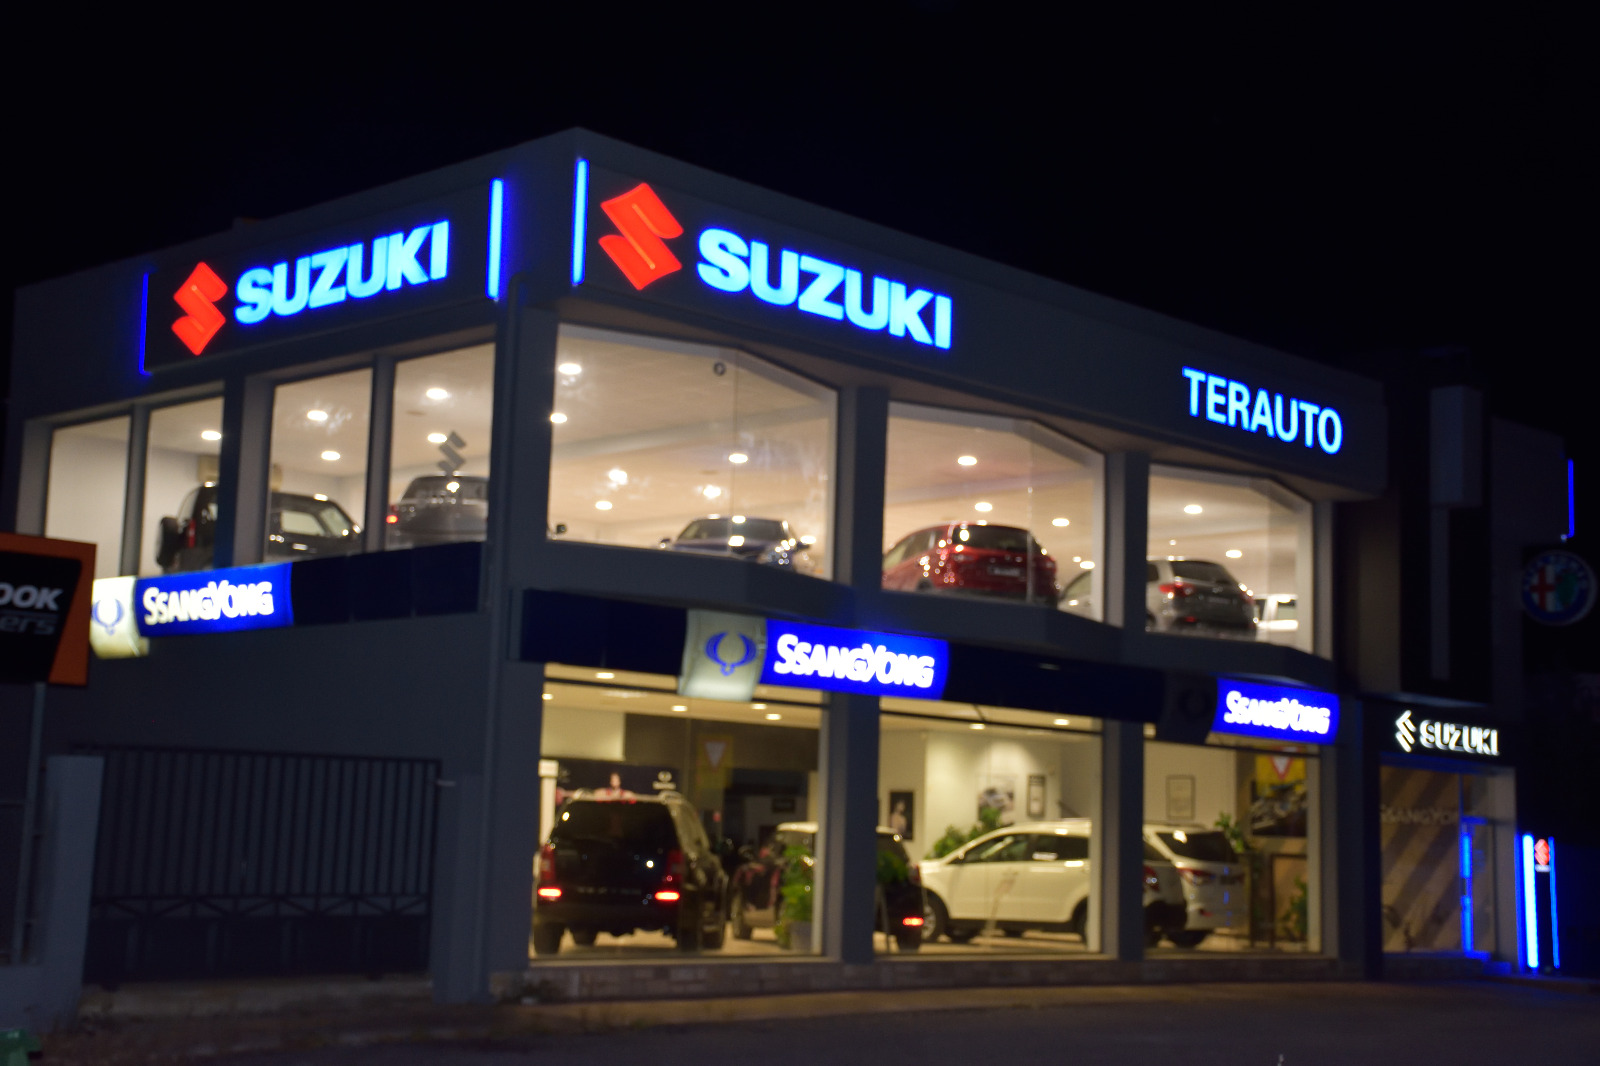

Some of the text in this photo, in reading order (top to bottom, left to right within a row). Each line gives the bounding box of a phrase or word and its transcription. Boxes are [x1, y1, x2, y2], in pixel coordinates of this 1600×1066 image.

[235, 220, 449, 324] SUZUKI
[697, 228, 952, 349] SUZUKI
[1183, 368, 1343, 454] TERAUTO
[1420, 719, 1499, 756] SUZUKI
